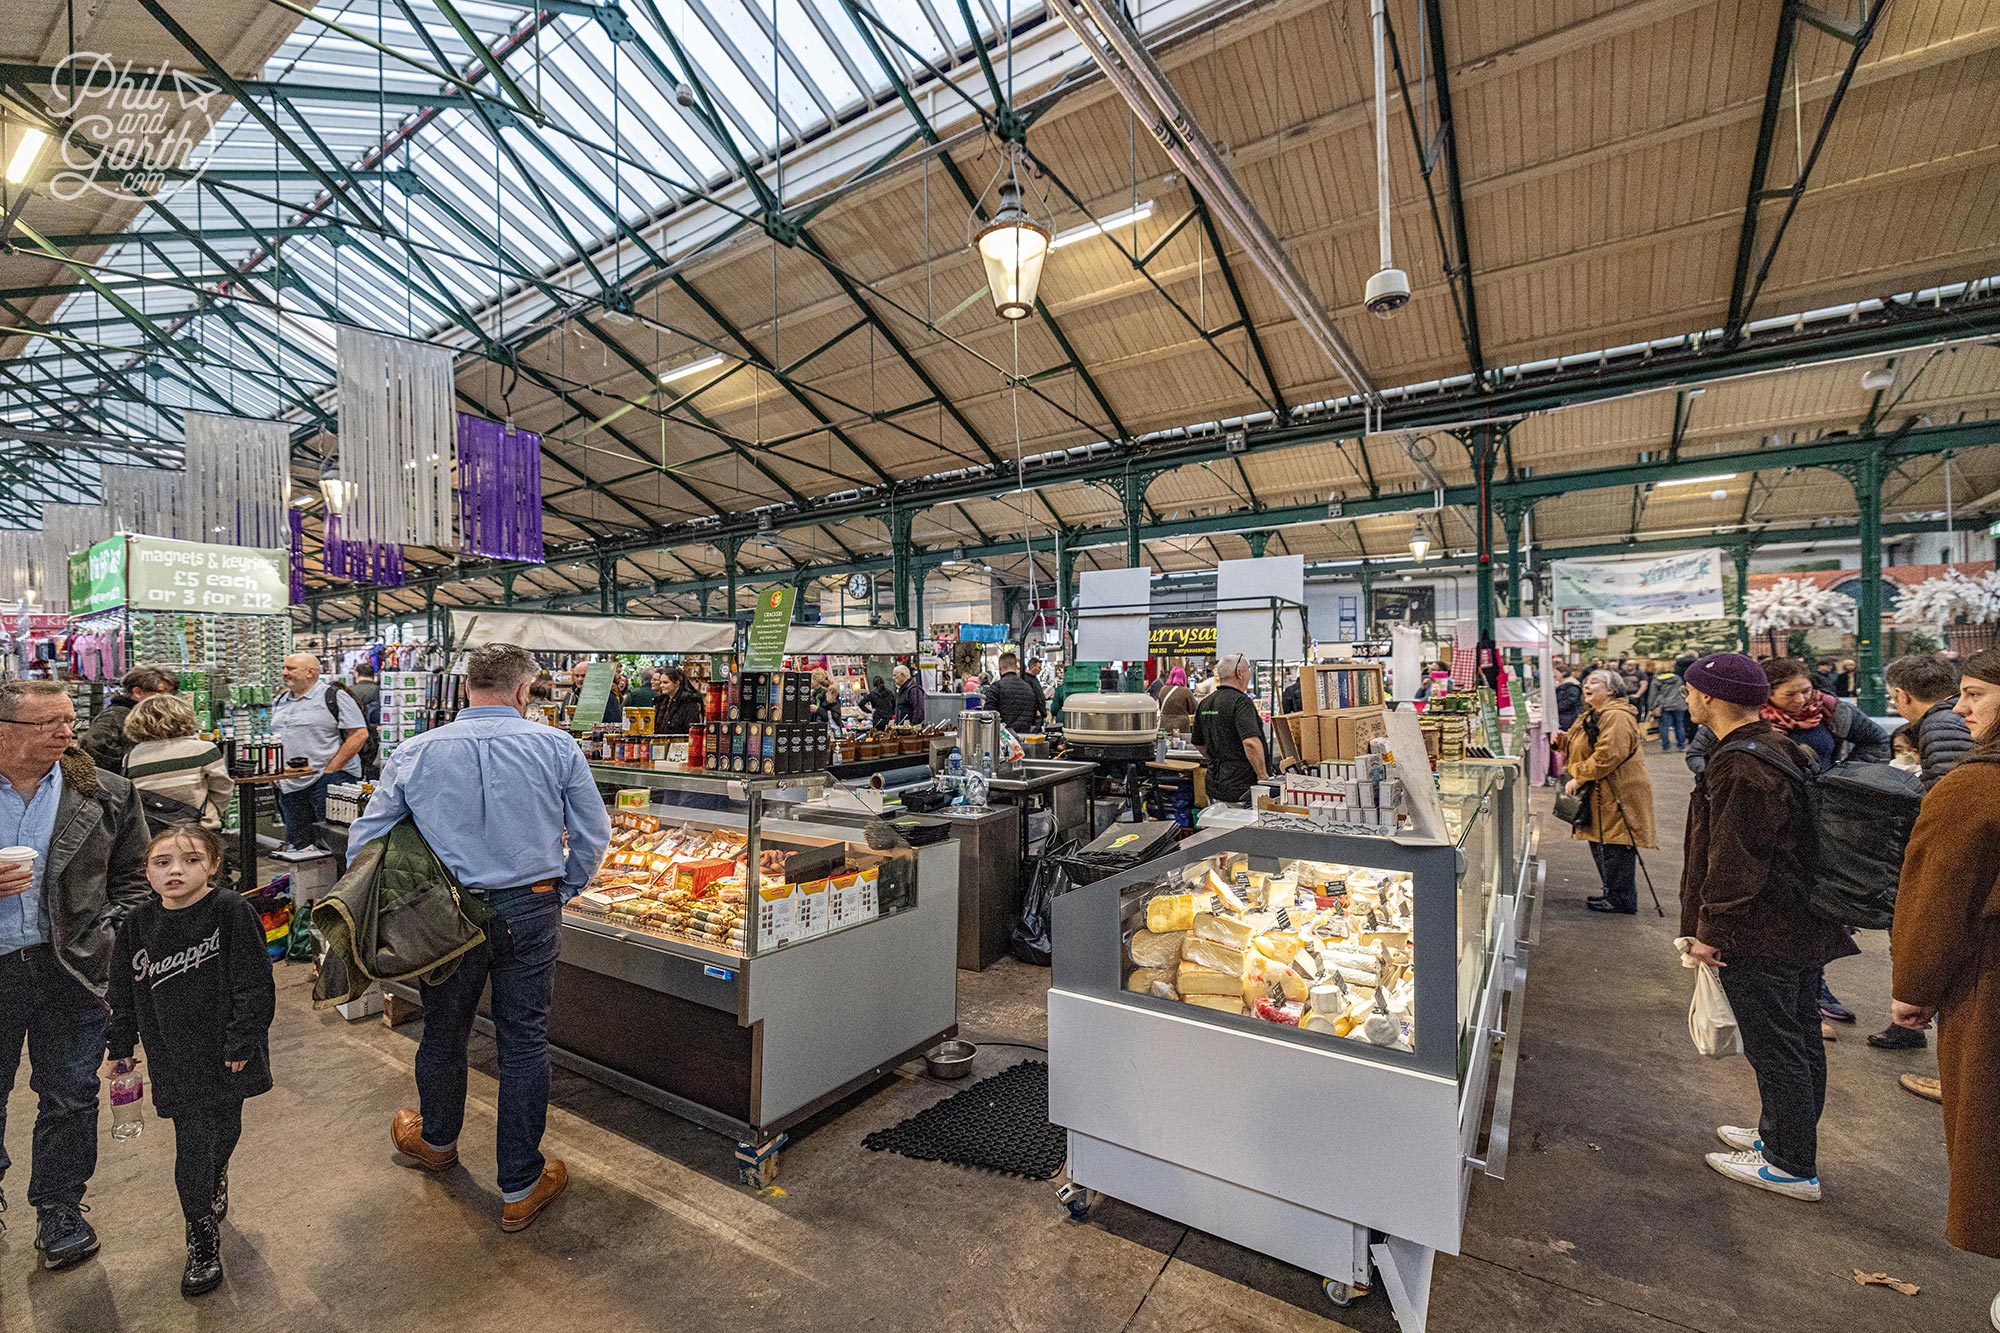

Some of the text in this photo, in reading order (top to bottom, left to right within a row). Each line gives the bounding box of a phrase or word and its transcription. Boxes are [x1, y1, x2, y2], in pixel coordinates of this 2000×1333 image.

[141, 549, 204, 571] magnets
[208, 554, 219, 570] &
[222, 554, 281, 576] keyrings
[173, 570, 259, 592] £5 each
[148, 588, 273, 609] or 3 for £12
